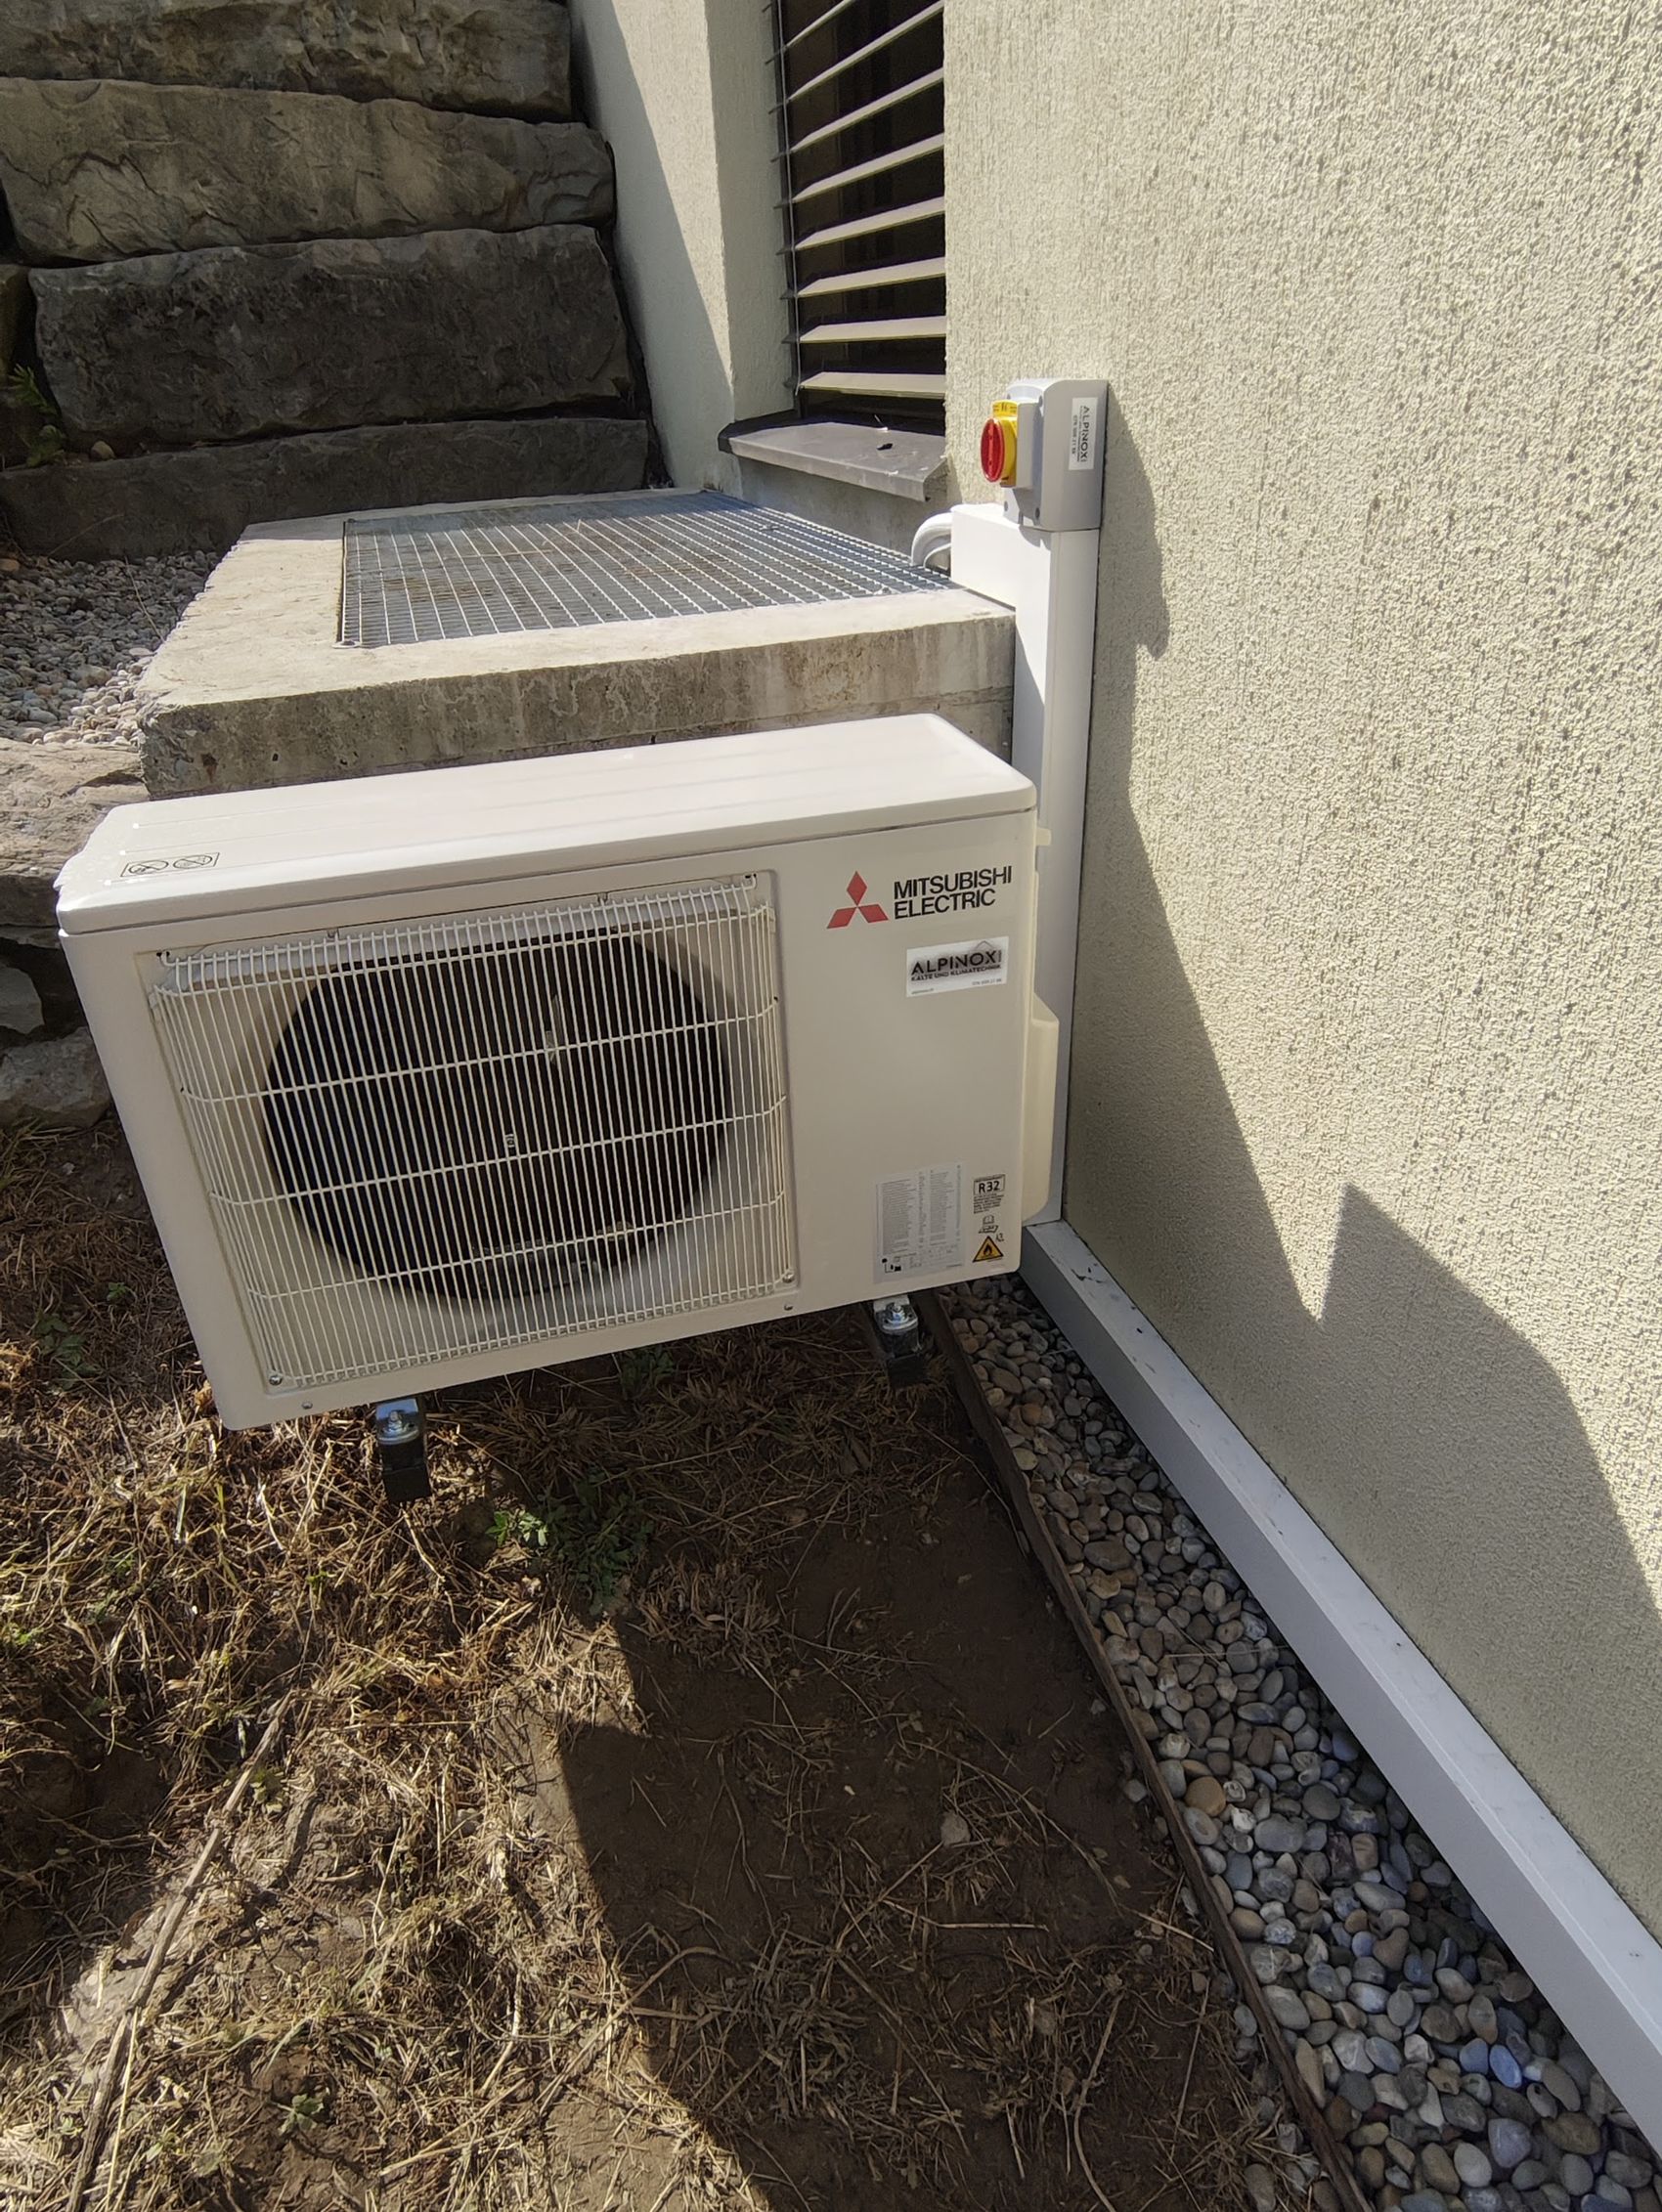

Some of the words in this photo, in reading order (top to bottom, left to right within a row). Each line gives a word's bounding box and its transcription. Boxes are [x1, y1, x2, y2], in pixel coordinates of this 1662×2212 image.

[1080, 406, 1090, 458] ALPINOX
[894, 866, 1012, 900] MITSUBISHI
[894, 889, 996, 920] ELECTRIC
[911, 950, 997, 976] ALPINOX
[979, 1180, 1000, 1194] R32
